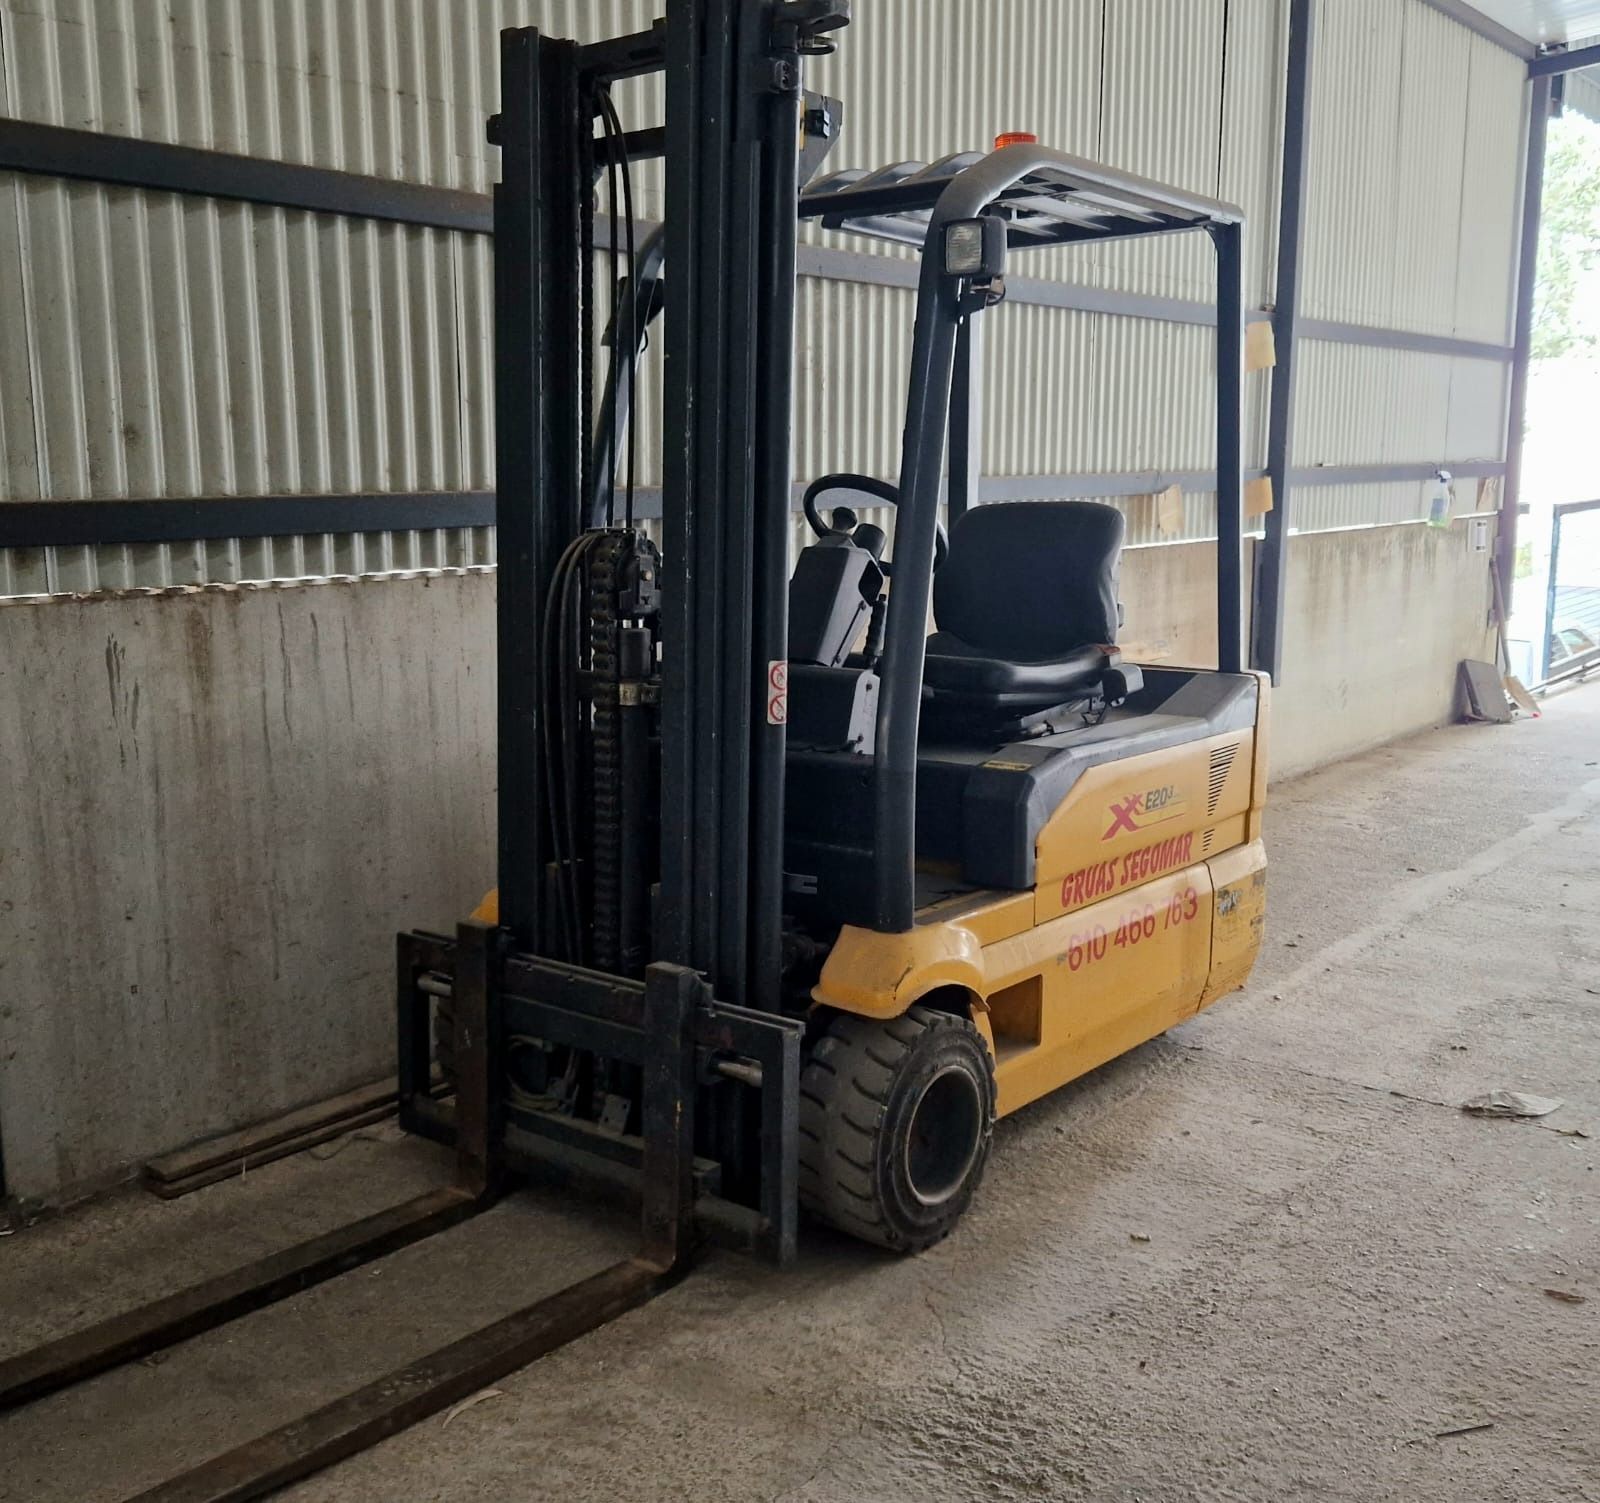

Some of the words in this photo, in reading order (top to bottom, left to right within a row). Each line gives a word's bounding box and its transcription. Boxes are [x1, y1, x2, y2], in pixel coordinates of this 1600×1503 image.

[1061, 857, 1119, 908] GRUAS
[1120, 831, 1193, 886] SEGOMAR
[1068, 923, 1107, 971] 610
[1113, 903, 1155, 949] 466
[1161, 886, 1198, 930] 763
